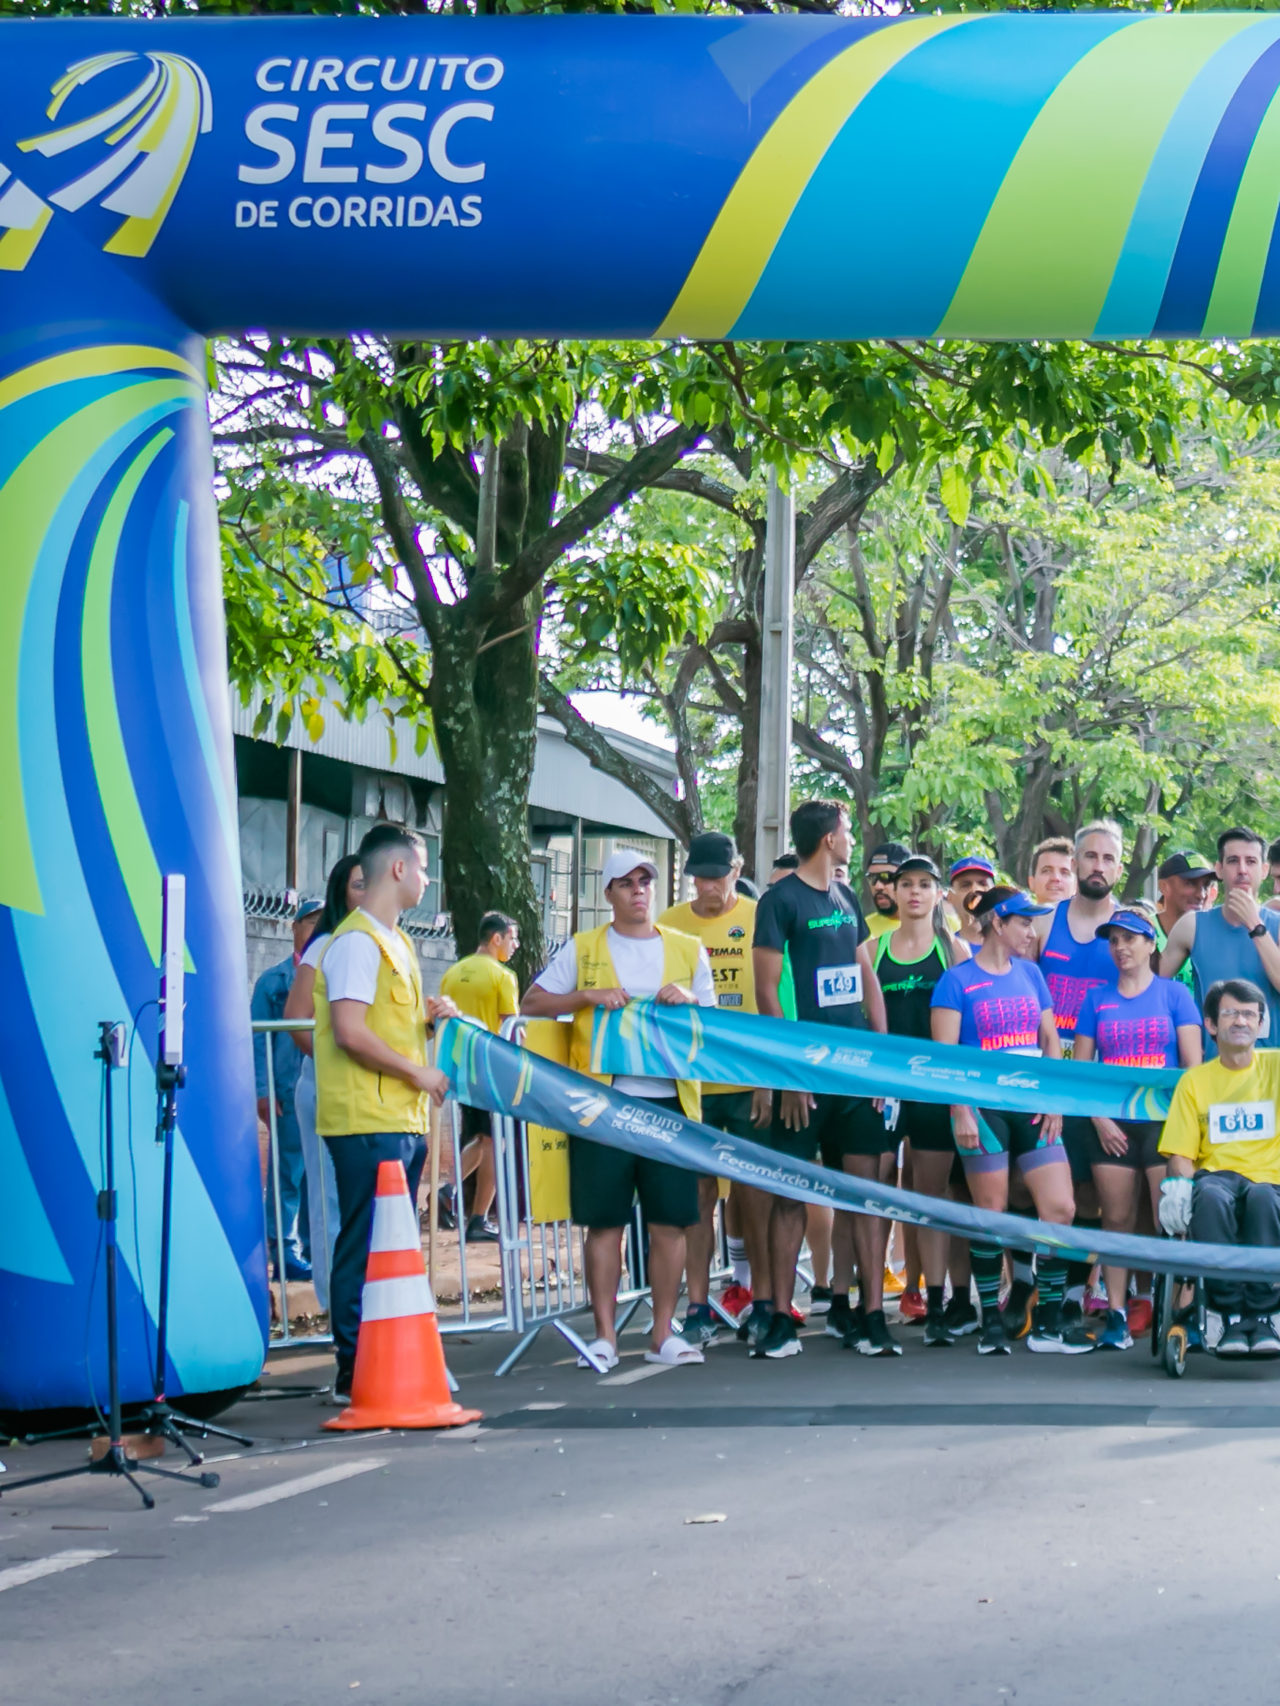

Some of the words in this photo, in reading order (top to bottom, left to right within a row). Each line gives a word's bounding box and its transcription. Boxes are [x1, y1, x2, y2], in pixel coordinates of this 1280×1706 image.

[255, 58, 505, 92] CIRCUITO
[237, 103, 496, 184] SESC
[235, 200, 279, 228] DE
[288, 196, 483, 228] CORRIDAS
[711, 968, 739, 982] EST
[828, 973, 853, 993] 149
[996, 1075, 1041, 1089] Sesc
[1225, 1112, 1257, 1130] 618
[717, 1150, 810, 1189] Fecomércio
